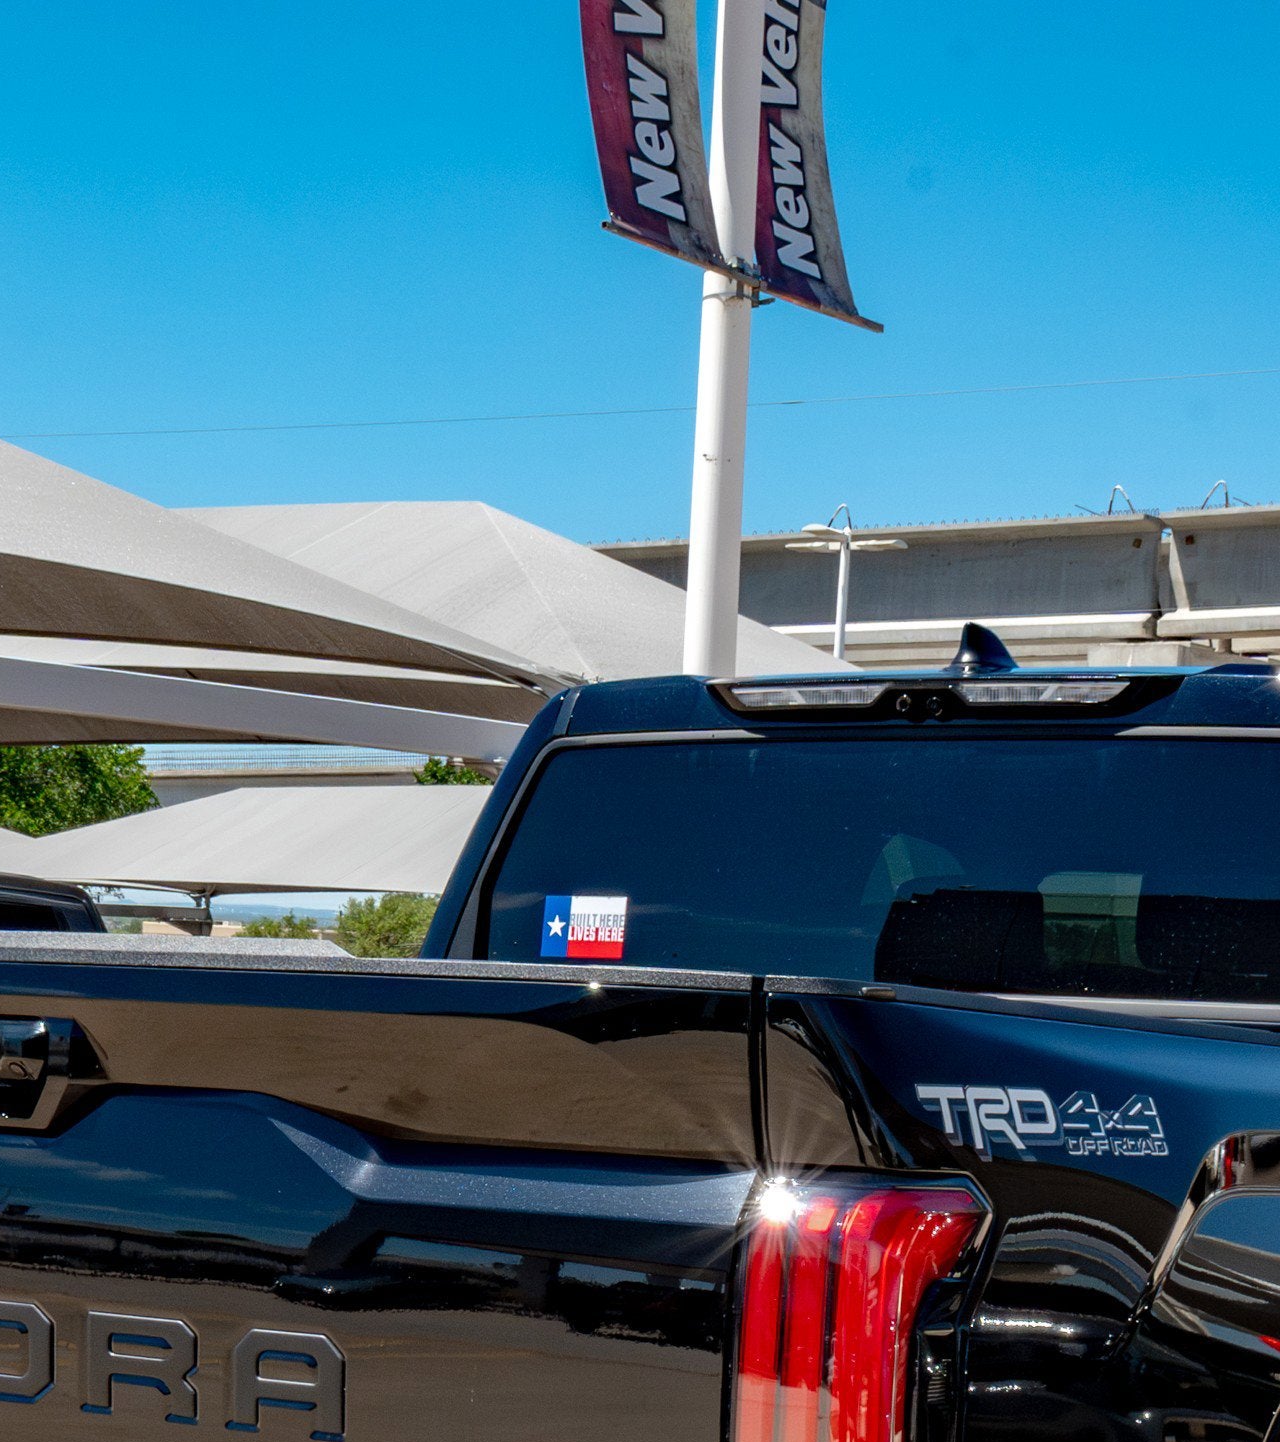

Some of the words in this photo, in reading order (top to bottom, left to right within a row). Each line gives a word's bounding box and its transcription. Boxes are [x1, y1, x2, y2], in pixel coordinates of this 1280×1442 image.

[626, 52, 687, 222] New
[768, 122, 822, 280] New
[568, 926, 598, 941] LIVES
[597, 927, 625, 942] HERE
[570, 913, 598, 928] BUILT
[599, 914, 625, 928] HERE
[915, 1084, 1063, 1157] TRD
[1065, 1137, 1109, 1155] OFF
[1109, 1137, 1169, 1156] ROAD
